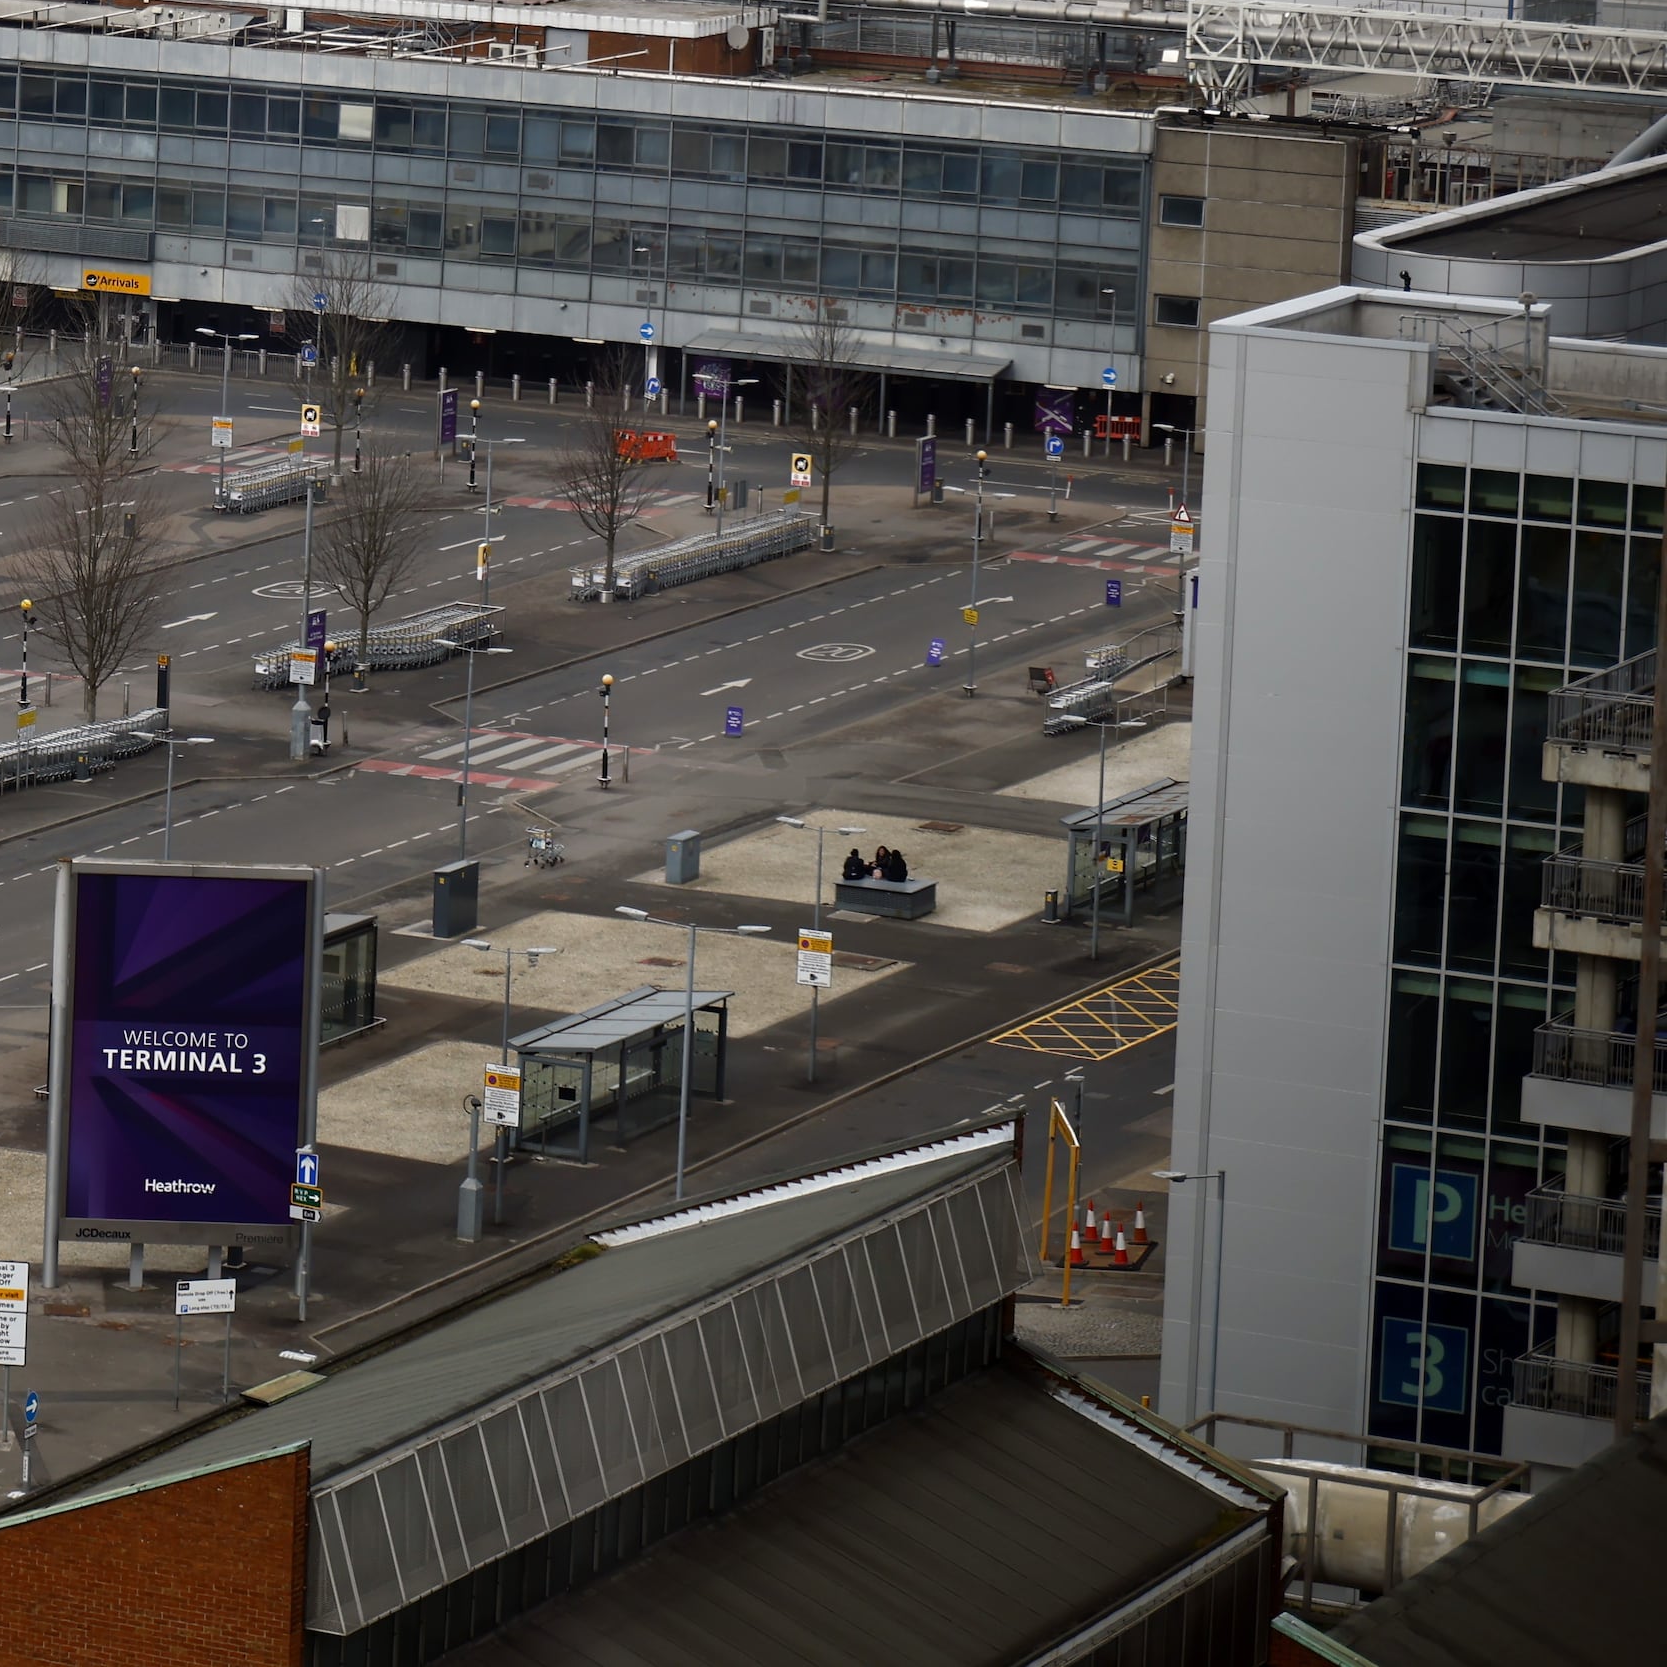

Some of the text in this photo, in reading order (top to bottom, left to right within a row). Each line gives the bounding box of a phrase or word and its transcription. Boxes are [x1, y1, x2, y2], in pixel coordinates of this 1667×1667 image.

[100, 276, 140, 289] Arrivals
[807, 645, 864, 659] 20
[123, 1030, 248, 1049] WELCOME TO
[103, 1048, 267, 1074] TERMINAL 3
[144, 1178, 216, 1194] Heathrow
[1412, 1178, 1463, 1244] P
[75, 1228, 131, 1240] JCDecaux
[0, 1322, 9, 1330] by
[1401, 1332, 1445, 1398] 3
